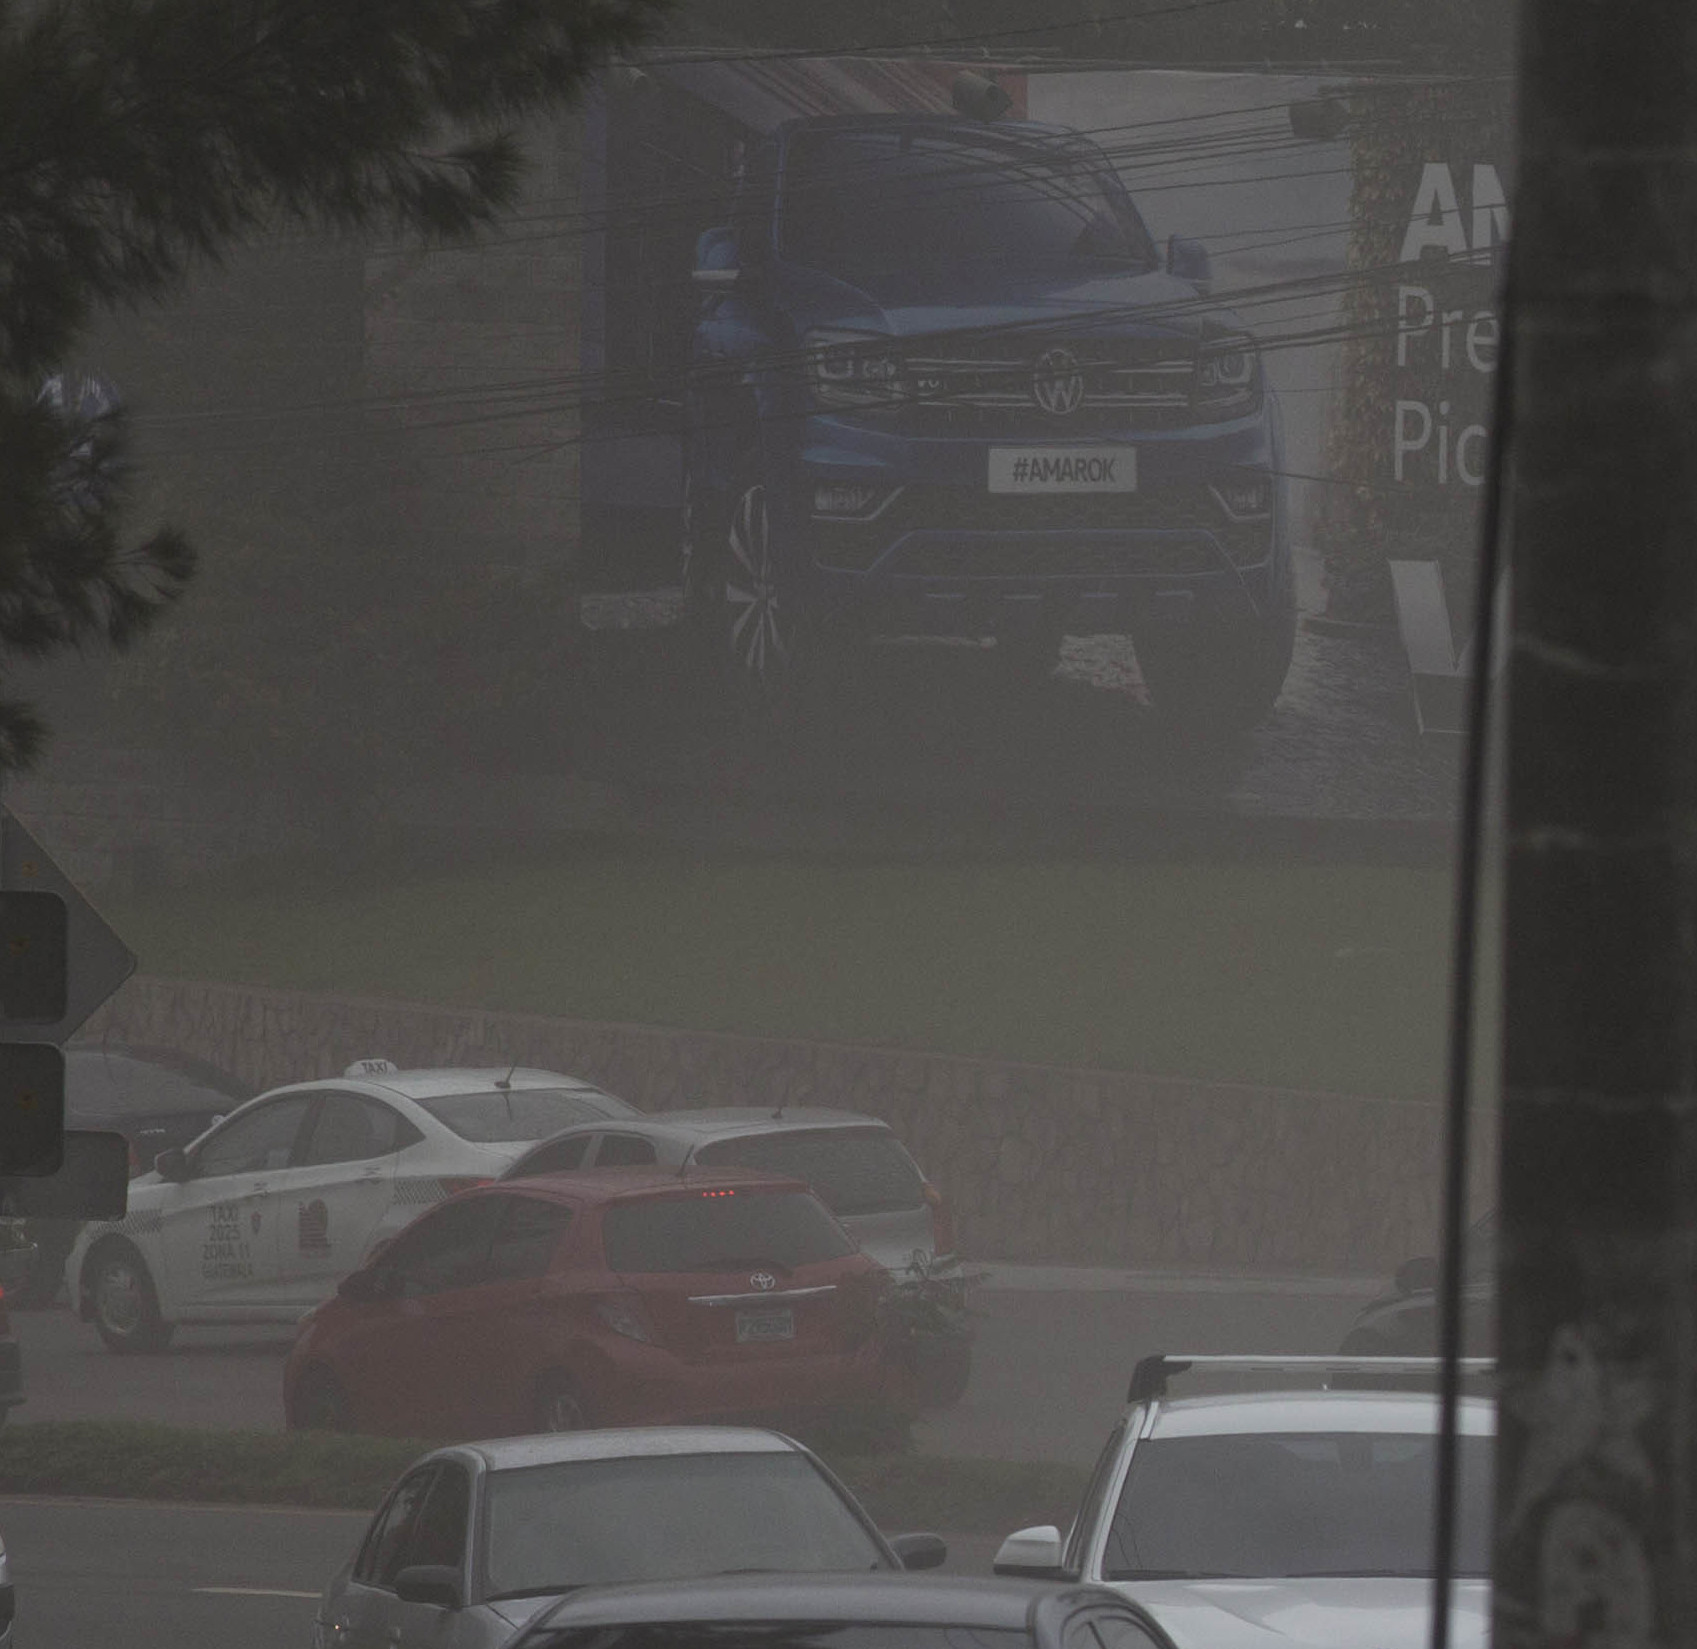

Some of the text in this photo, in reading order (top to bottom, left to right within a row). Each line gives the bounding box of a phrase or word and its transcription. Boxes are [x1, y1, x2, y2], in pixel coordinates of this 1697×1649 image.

[1012, 456, 1116, 483] #AMAROK
[360, 1061, 388, 1075] TAXI
[209, 1203, 239, 1222] TAXI
[202, 1242, 235, 1261] ZONA
